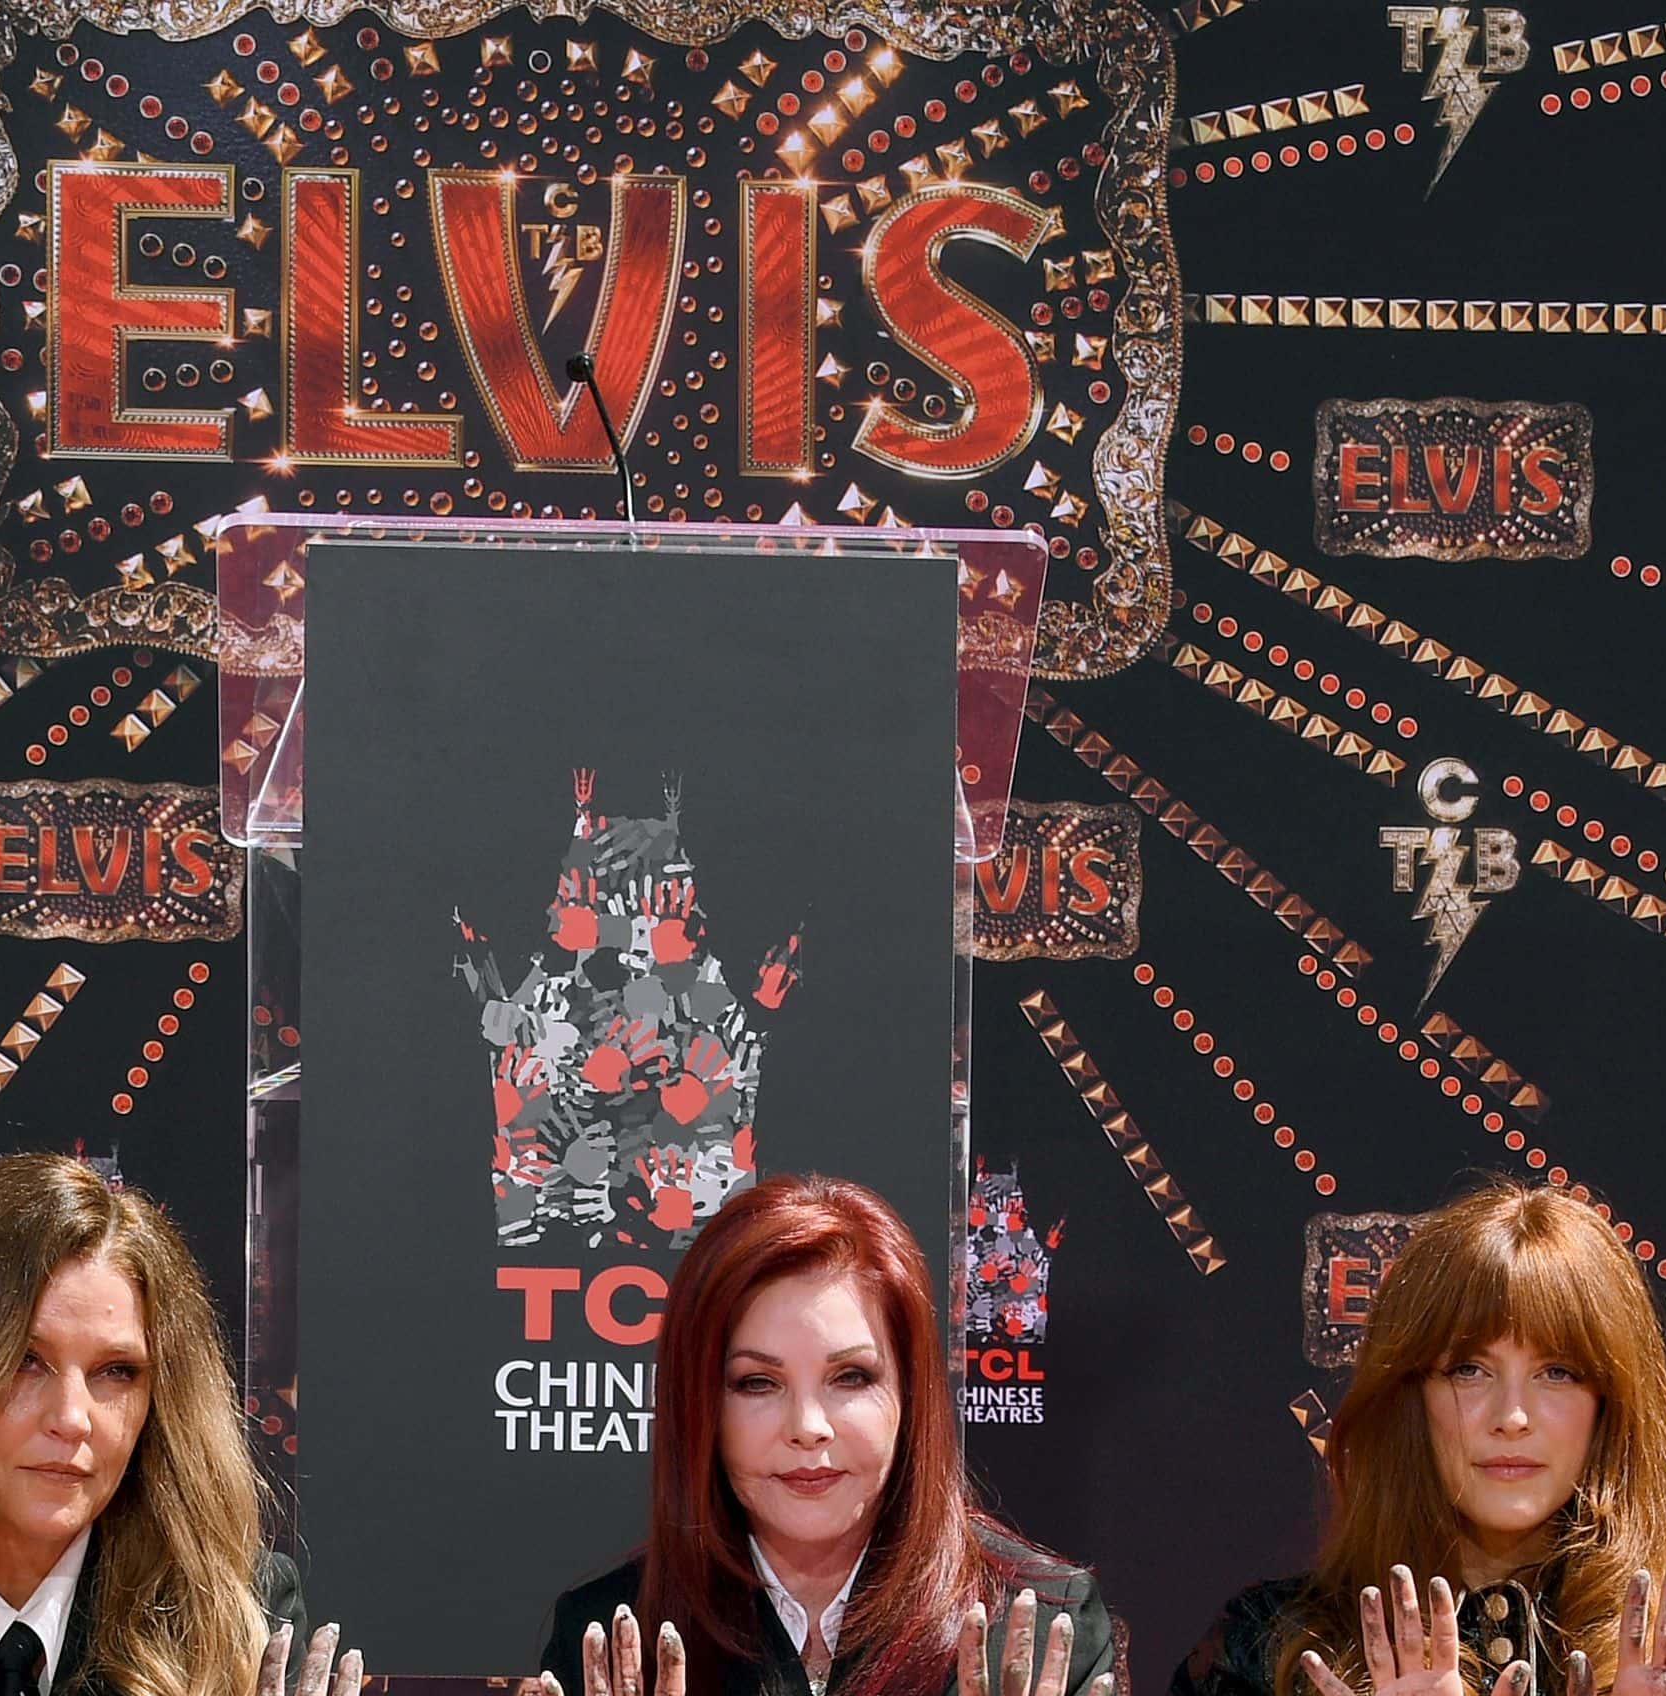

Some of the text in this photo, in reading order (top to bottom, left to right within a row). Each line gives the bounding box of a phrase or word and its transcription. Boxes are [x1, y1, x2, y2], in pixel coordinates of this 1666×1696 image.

[40, 157, 1063, 480] ELVIS
[1337, 442, 1566, 516] ELVIS
[972, 844, 1116, 916] VIS
[496, 1265, 669, 1345] TC
[495, 1360, 658, 1409] CHIN
[495, 1410, 655, 1452] THEAT
